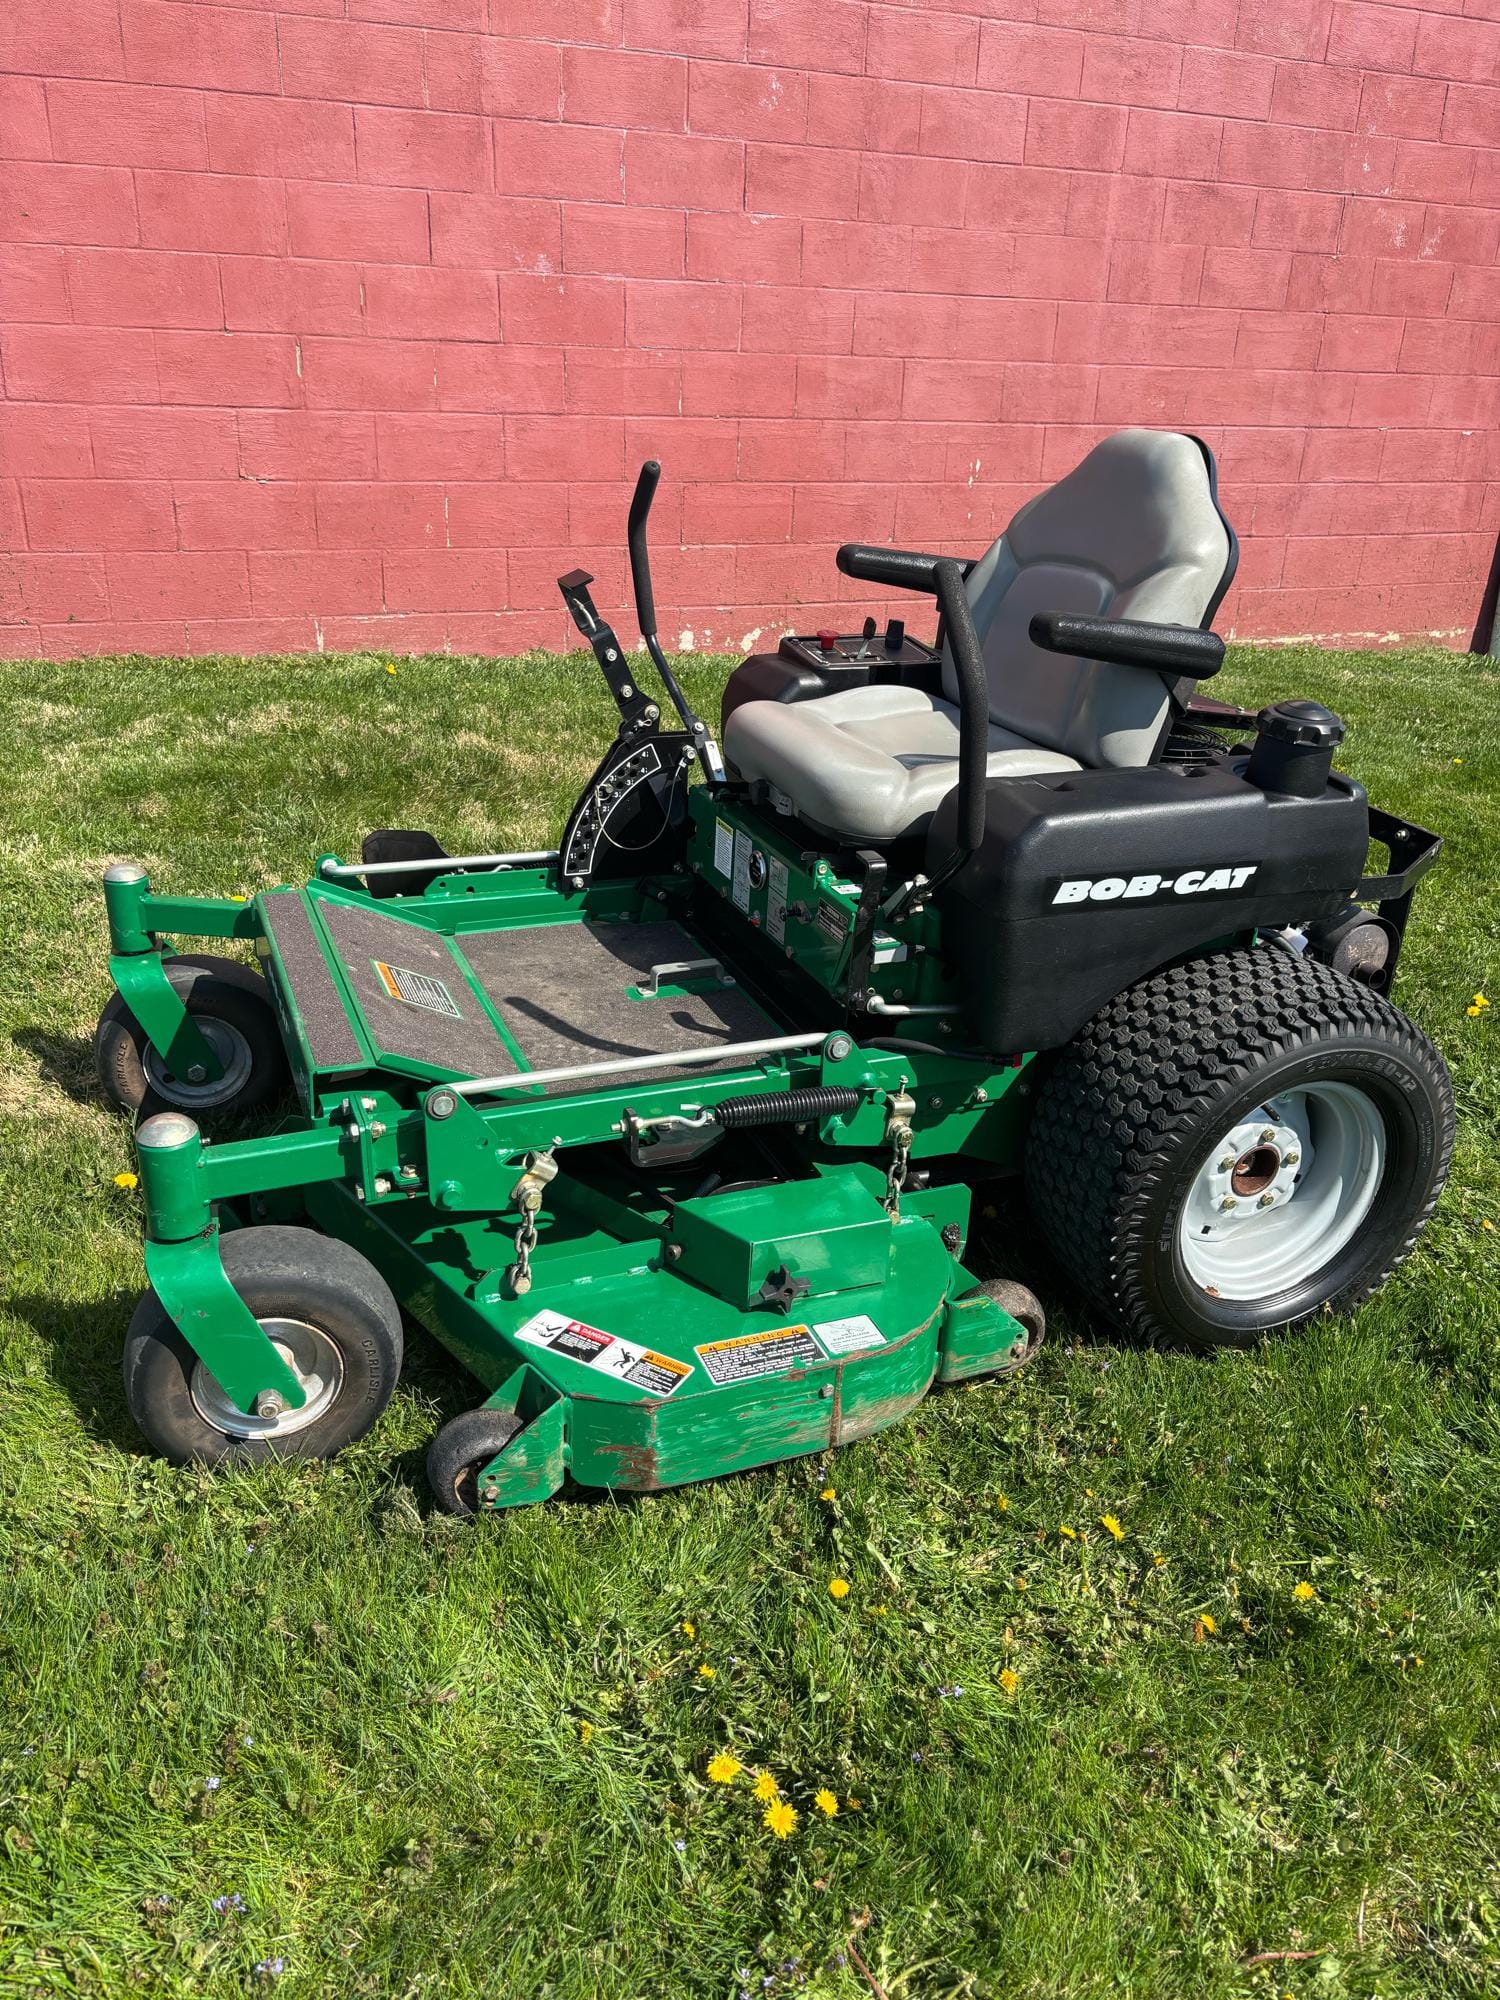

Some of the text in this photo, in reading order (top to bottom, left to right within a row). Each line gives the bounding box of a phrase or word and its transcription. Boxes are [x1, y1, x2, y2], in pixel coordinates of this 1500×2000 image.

[1052, 866, 1258, 904] BOB-CAT
[117, 1042, 131, 1095] CARLISLE
[582, 1328, 611, 1343] DANGER
[723, 1330, 785, 1348] WARNING
[361, 1339, 380, 1404] CARLISLE
[656, 1356, 690, 1375] WARNING
